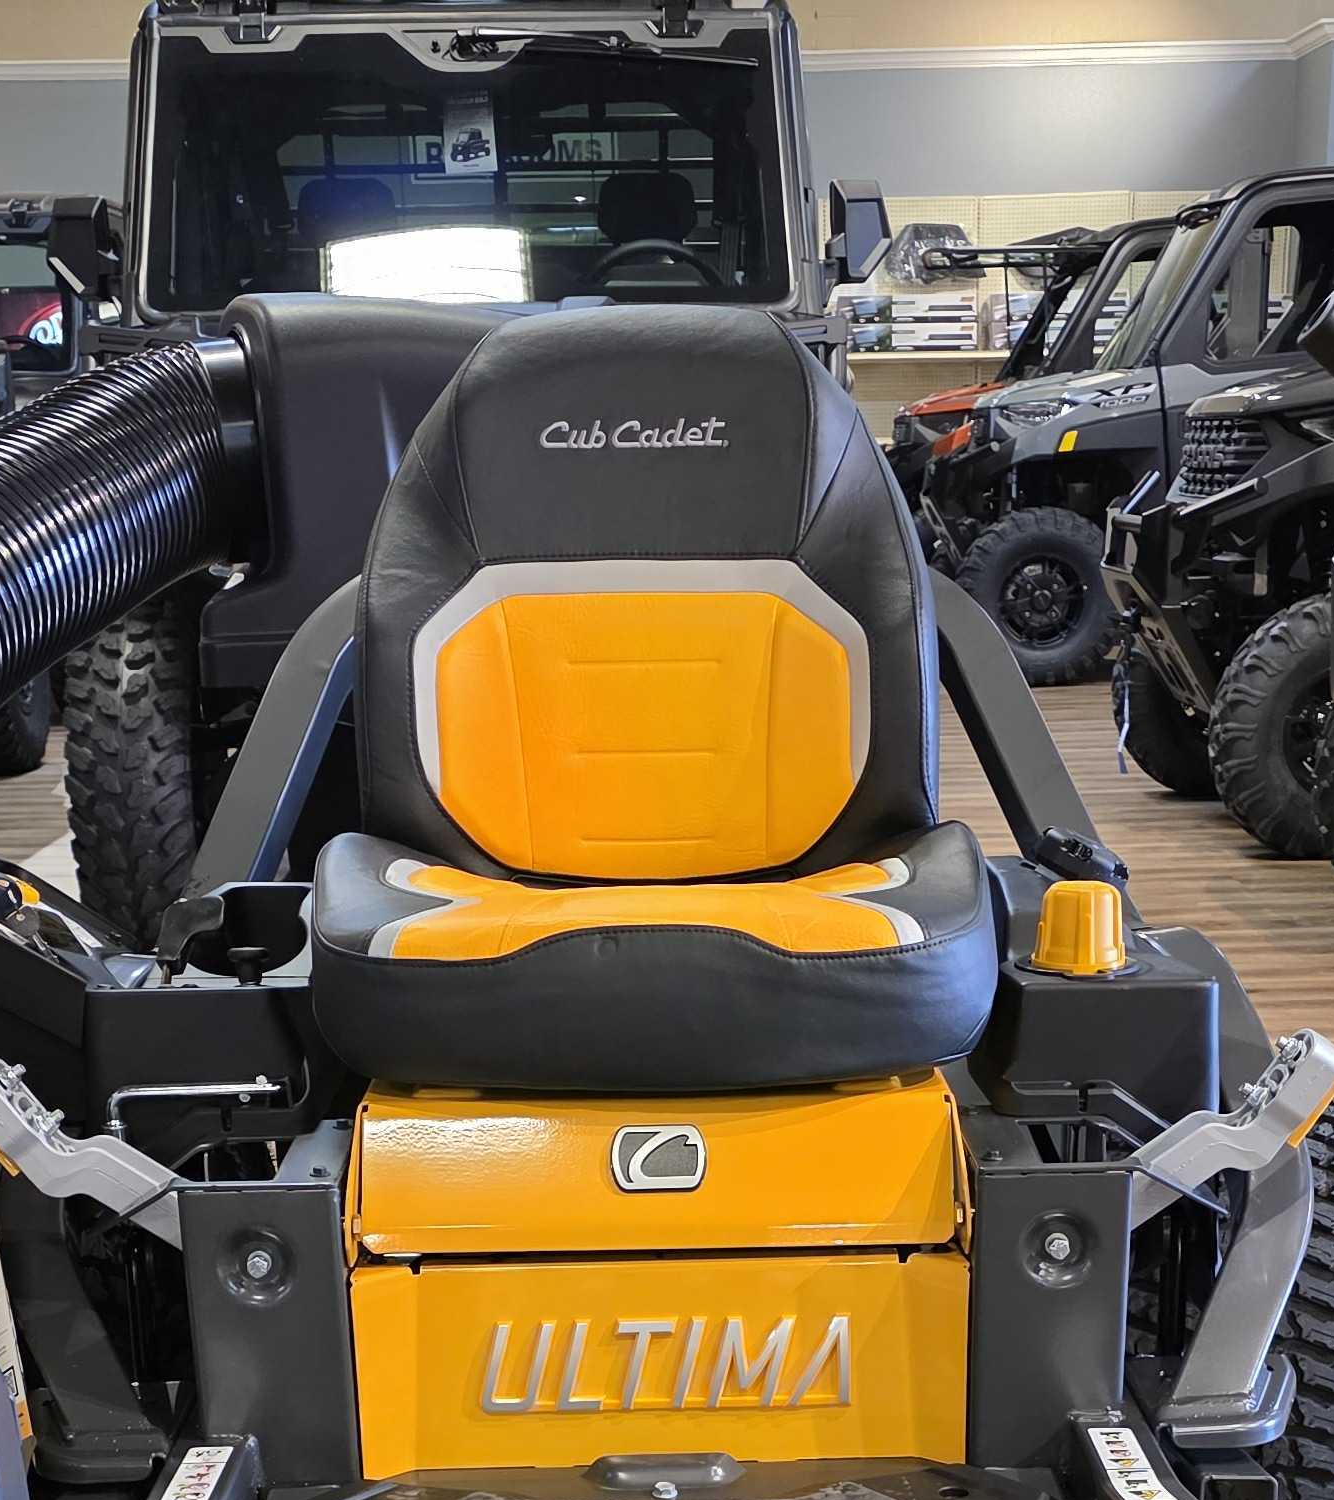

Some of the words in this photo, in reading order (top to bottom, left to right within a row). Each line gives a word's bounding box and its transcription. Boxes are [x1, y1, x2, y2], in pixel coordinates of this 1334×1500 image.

[1091, 382, 1156, 399] XP
[1099, 394, 1149, 409] 1000
[539, 419, 607, 449] Cub
[611, 416, 726, 449] Cadet
[481, 1315, 851, 1415] ULTIMA
